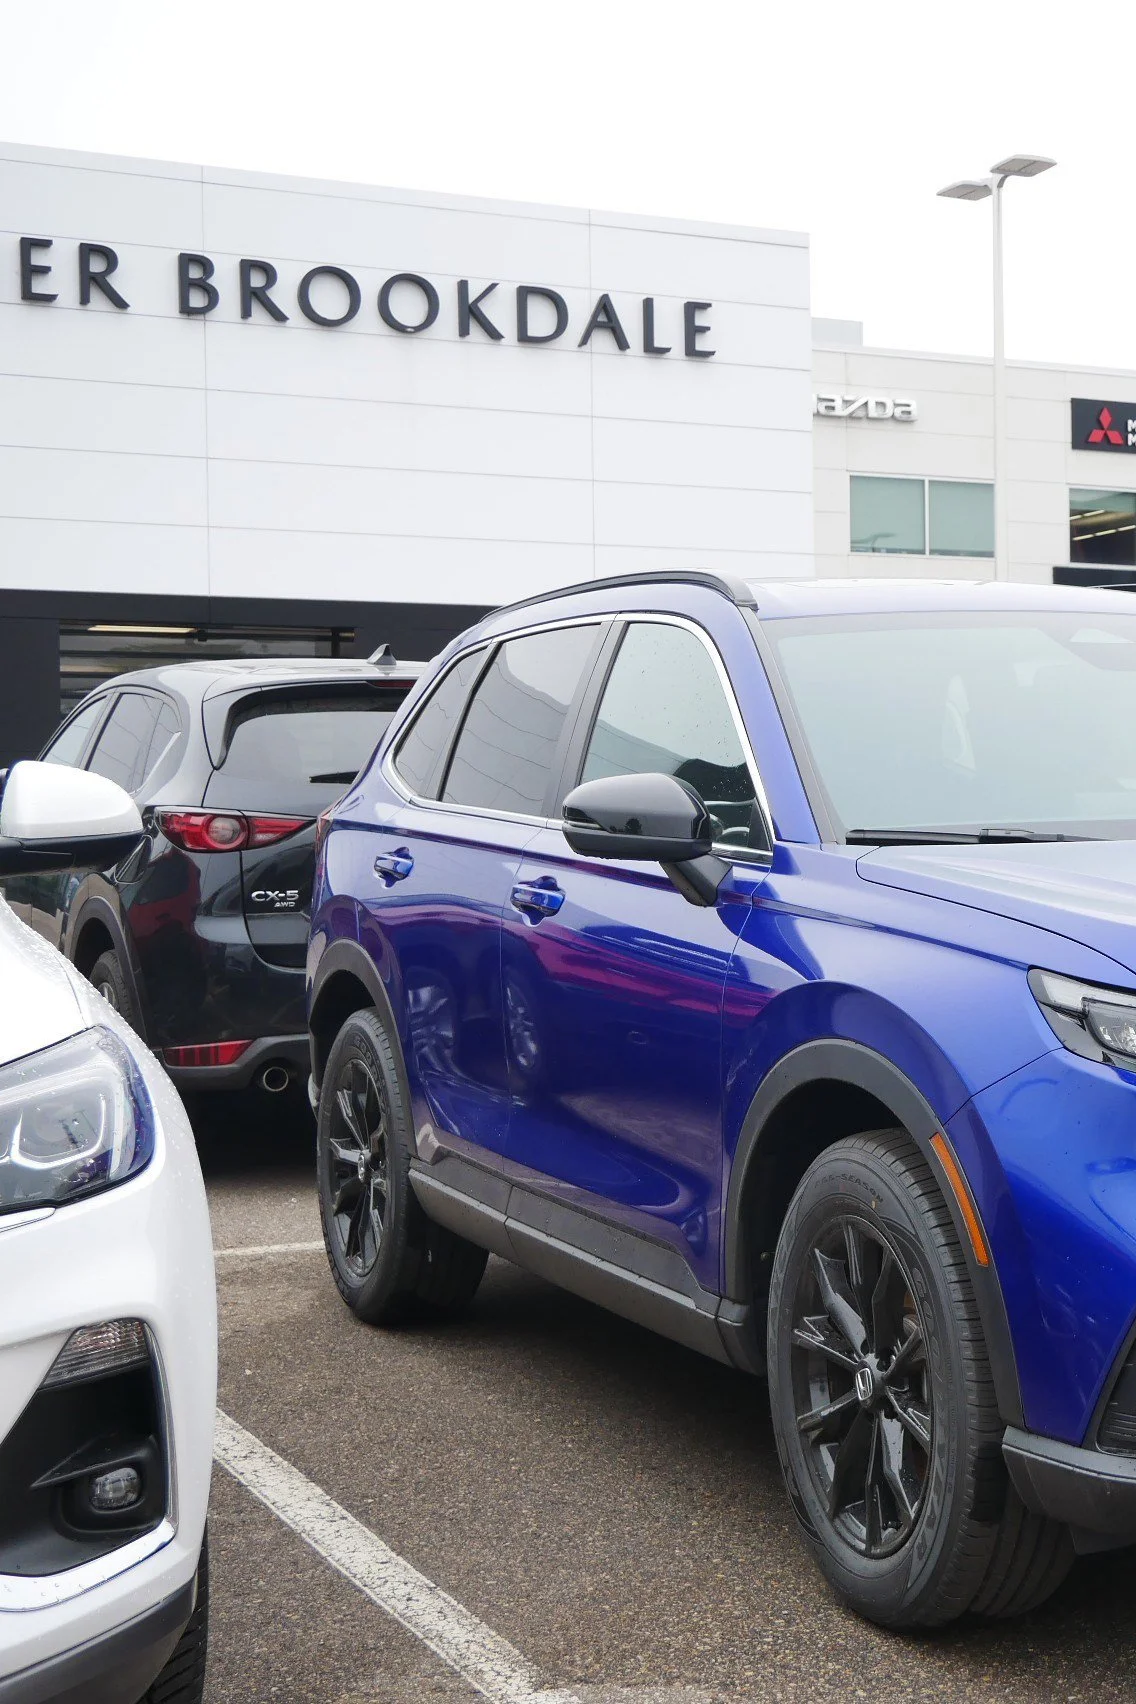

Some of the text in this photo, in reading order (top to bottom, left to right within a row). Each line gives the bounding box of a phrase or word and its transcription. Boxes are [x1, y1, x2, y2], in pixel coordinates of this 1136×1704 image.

[20, 237, 718, 358] ER BROOKDALE
[251, 889, 299, 901] CX-5
